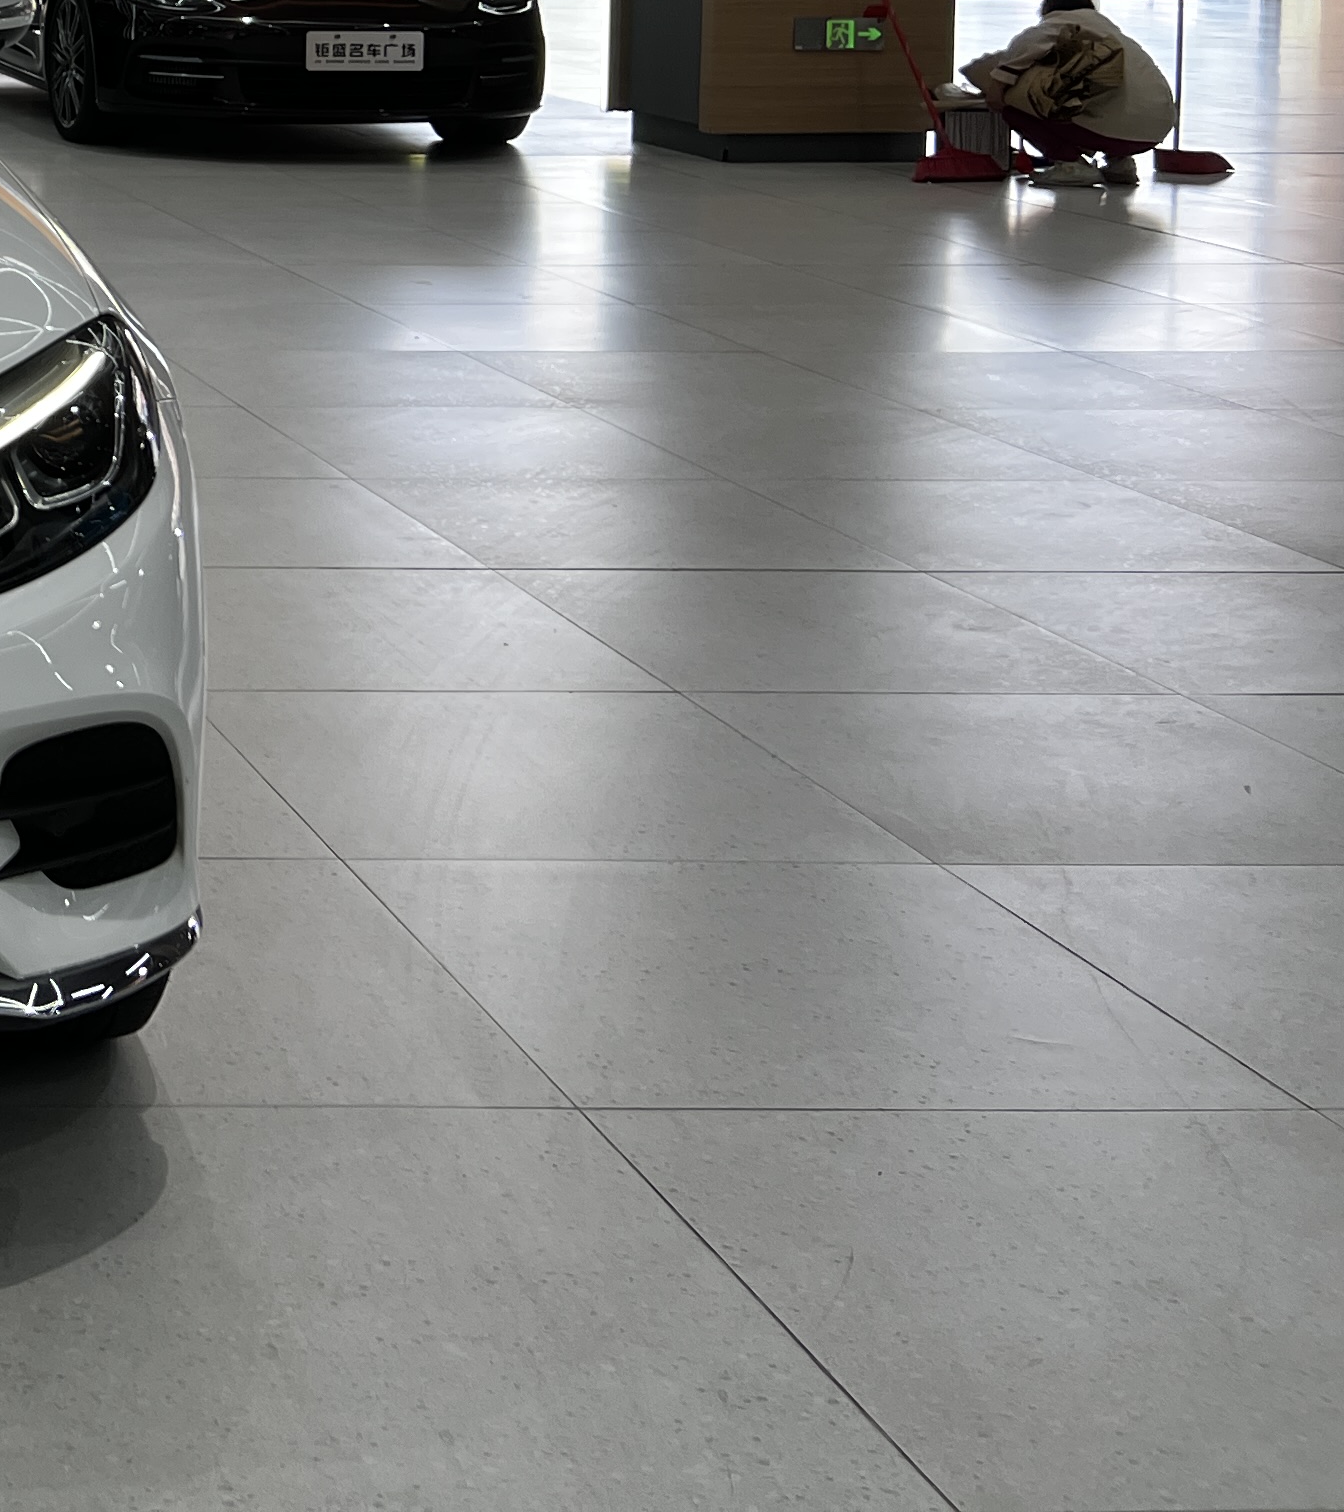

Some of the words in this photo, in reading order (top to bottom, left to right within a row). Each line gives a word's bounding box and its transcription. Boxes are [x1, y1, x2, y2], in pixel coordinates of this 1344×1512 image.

[314, 42, 416, 58] 钜盛名车广场
